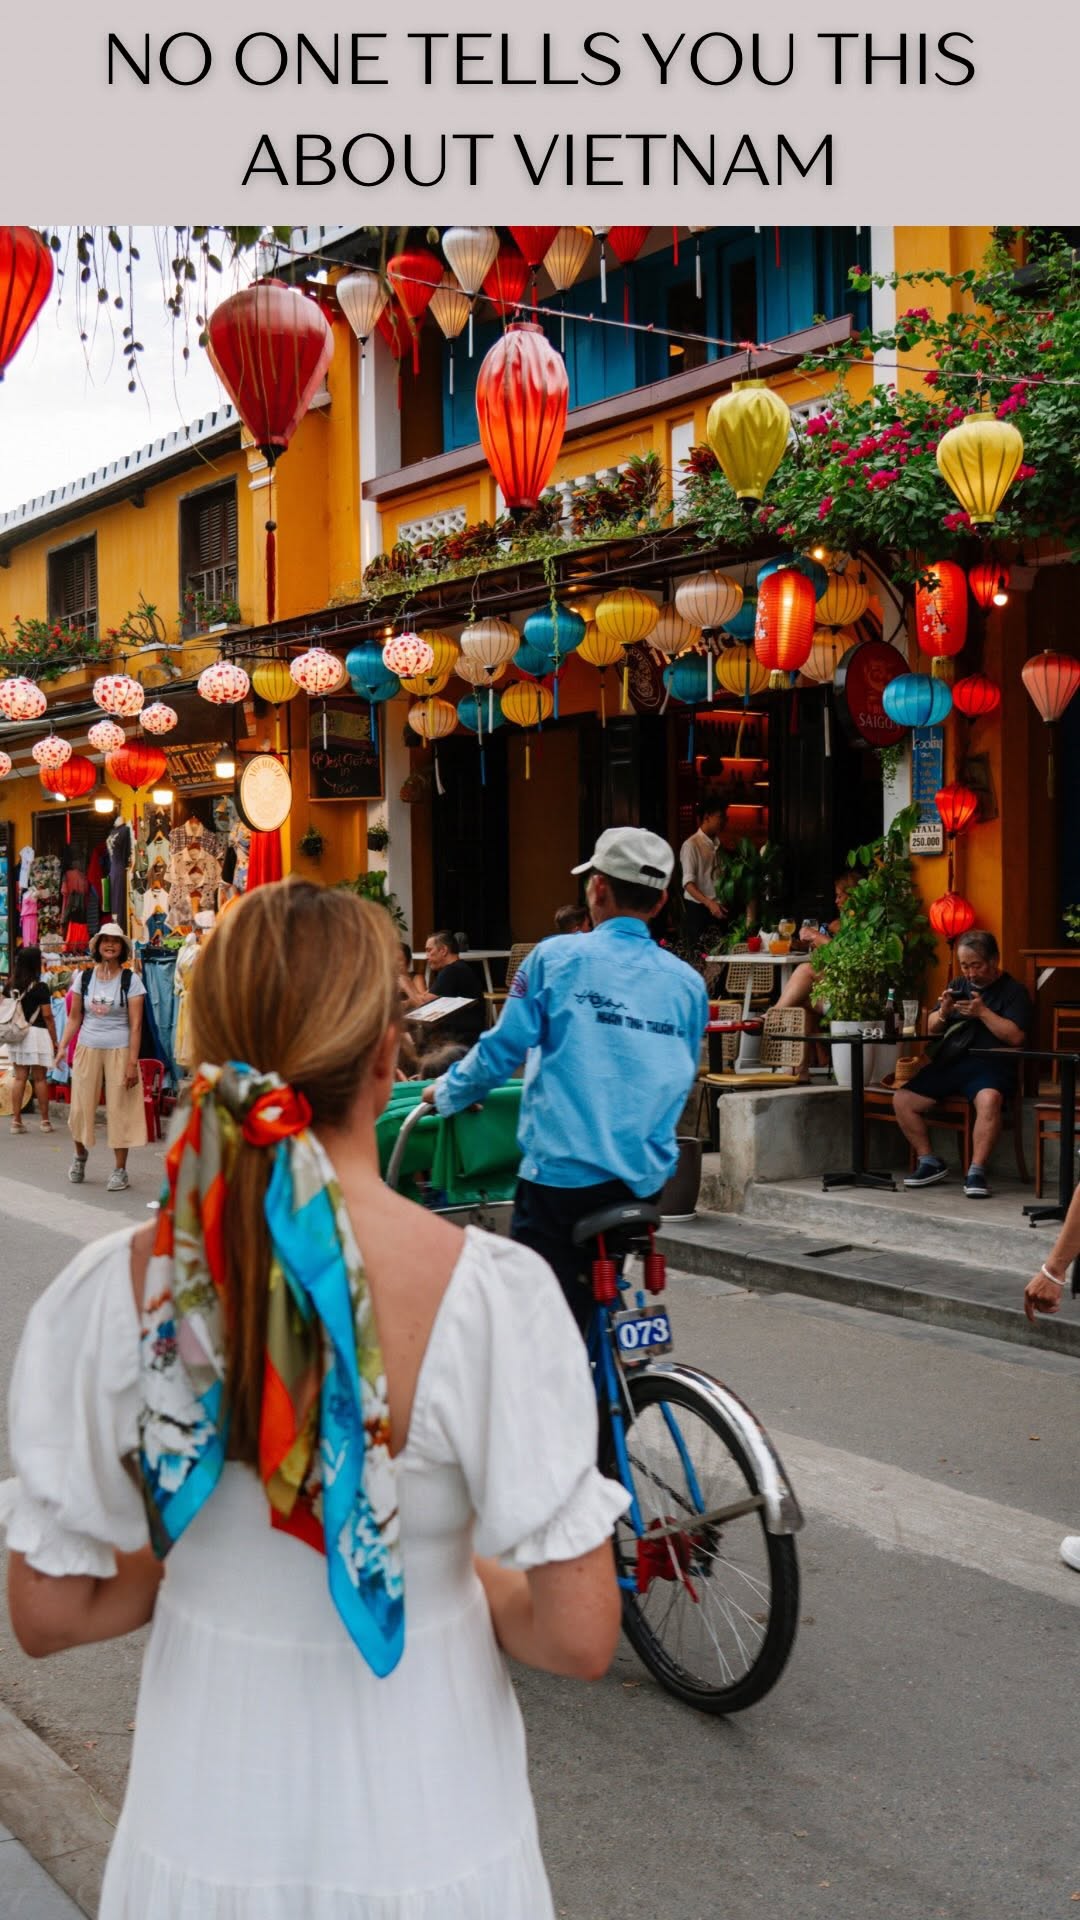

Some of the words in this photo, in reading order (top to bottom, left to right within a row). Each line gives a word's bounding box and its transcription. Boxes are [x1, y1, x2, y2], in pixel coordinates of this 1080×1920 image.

[859, 711, 901, 731] SAIGO
[917, 825, 937, 834] TAXI
[911, 836, 940, 847] 250.000
[619, 1318, 670, 1348] 073
